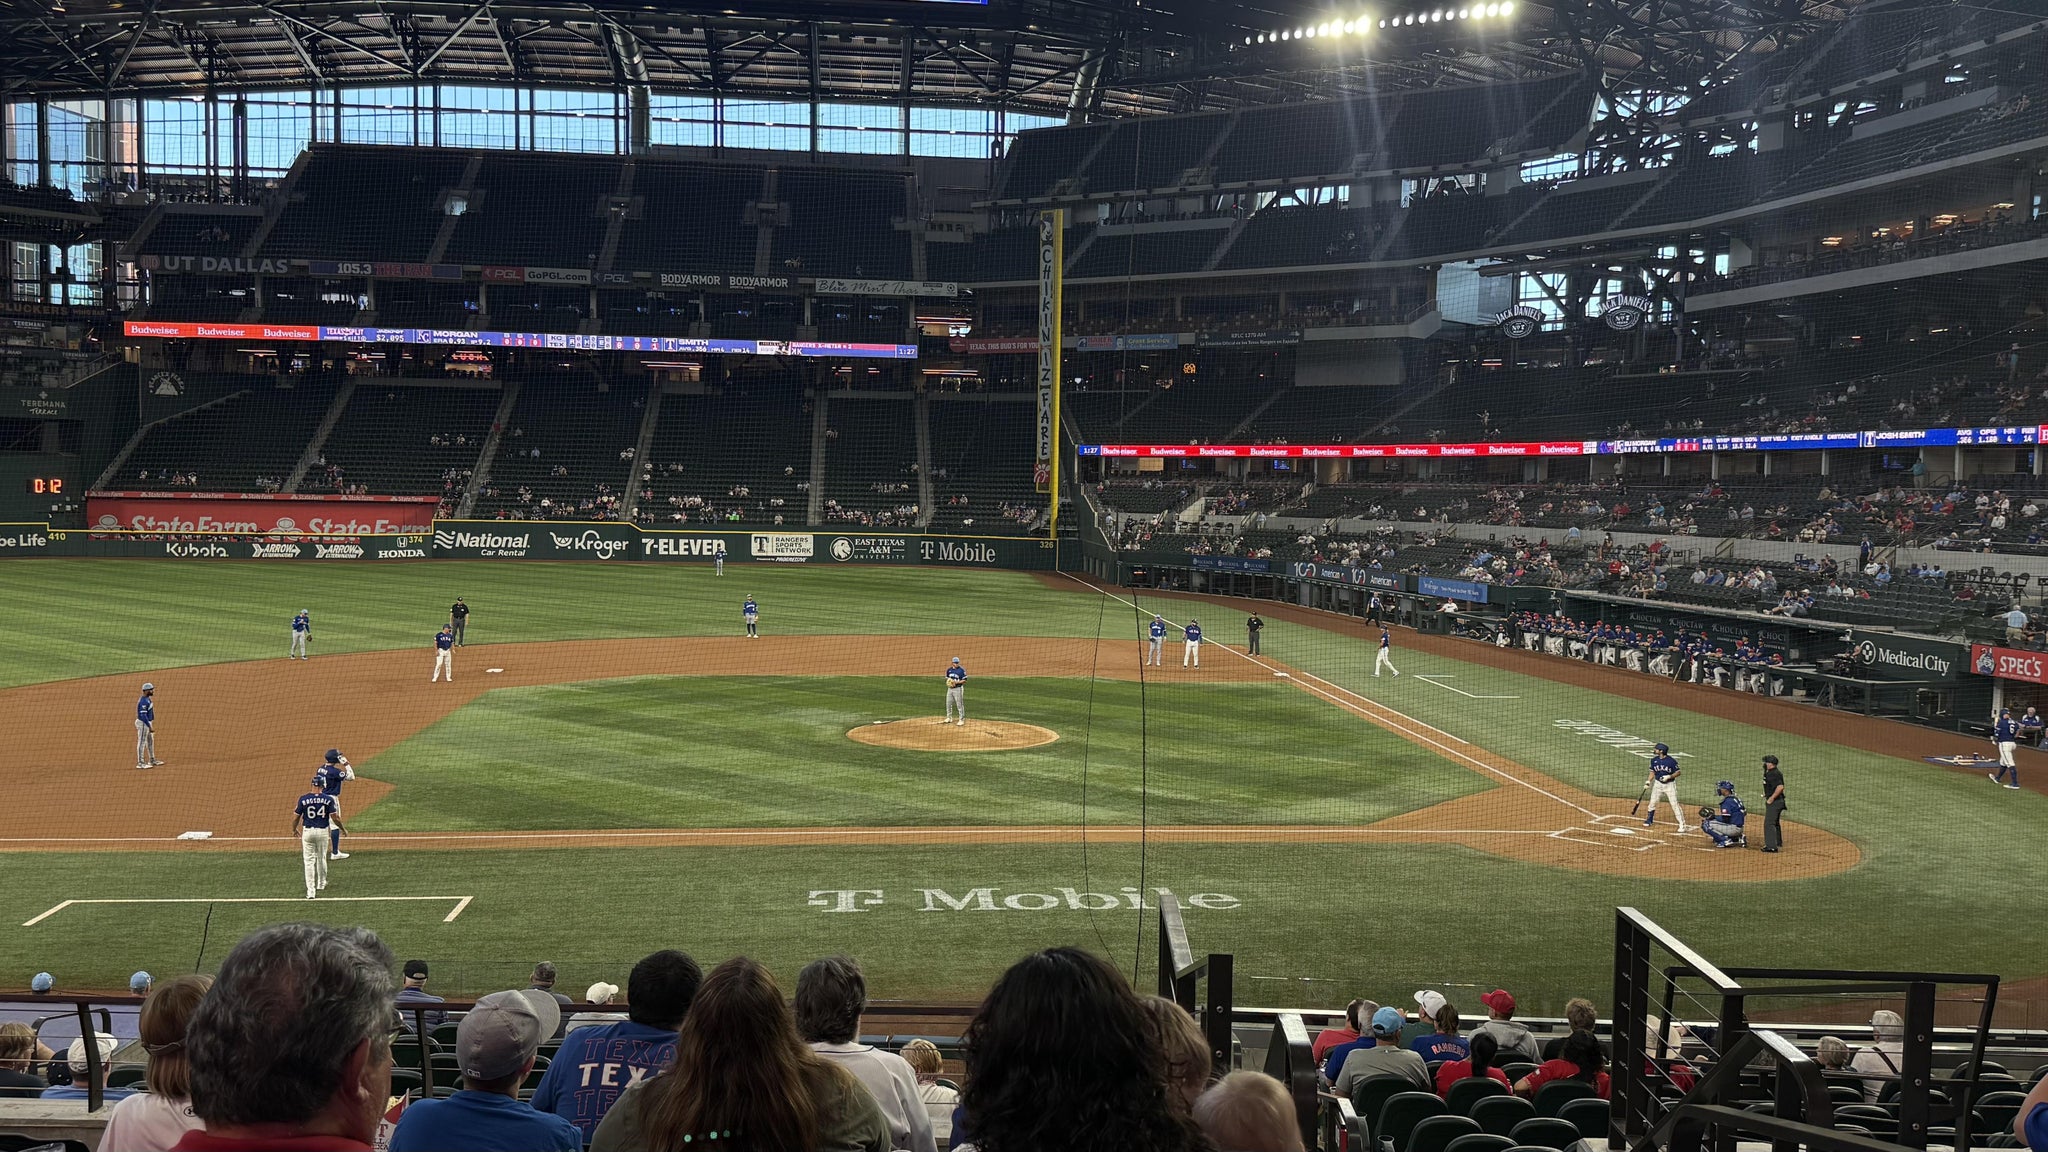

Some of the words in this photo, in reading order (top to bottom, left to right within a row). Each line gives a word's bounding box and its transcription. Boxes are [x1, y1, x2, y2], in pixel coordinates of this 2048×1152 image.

[164, 255, 196, 271] UT
[202, 256, 289, 274] DALLAS
[337, 263, 372, 275] 105.3
[528, 271, 588, 282] GoPGL.com
[660, 273, 721, 286] BODYARMOR
[729, 276, 789, 288] BODYARMOR
[817, 279, 849, 292] Blue
[850, 282, 891, 294] Mint
[1597, 299, 1617, 316] JACK
[1495, 308, 1514, 326] JACK
[433, 330, 478, 338] MORGAN
[1041, 352, 1051, 382] IZ
[20, 400, 66, 408] TEREMANA
[1040, 393, 1050, 456] FARE
[1875, 432, 1898, 440] JOSH
[1899, 431, 1926, 439] SMITH
[2023, 435, 2032, 443] 14
[34, 478, 62, 494] 0:12
[19, 534, 47, 547] Life
[48, 532, 66, 541] 410
[408, 536, 423, 544] 374
[455, 531, 528, 549] National
[855, 538, 877, 546] EAST
[263, 544, 293, 553] ARROW
[326, 545, 357, 554] ARROW
[868, 546, 891, 554] A&M
[1039, 541, 1054, 549] 326
[378, 550, 426, 559] HONDA
[480, 549, 500, 557] Car
[500, 548, 526, 557] Rental
[920, 541, 934, 560] T
[938, 541, 996, 563] Mobile
[1321, 568, 1341, 579] American
[1369, 575, 1392, 587] American
[1629, 612, 1662, 624] CHOCTAW
[1668, 617, 1704, 629] CHOCTAW
[1878, 647, 1923, 669] Medical
[1924, 654, 1951, 677] City
[1999, 656, 2043, 677] SPEC'S
[2009, 724, 2015, 734] 6
[1653, 765, 1672, 773] TEXAS
[307, 806, 326, 818] 64
[808, 889, 883, 913] T
[913, 887, 1242, 911] Mobile
